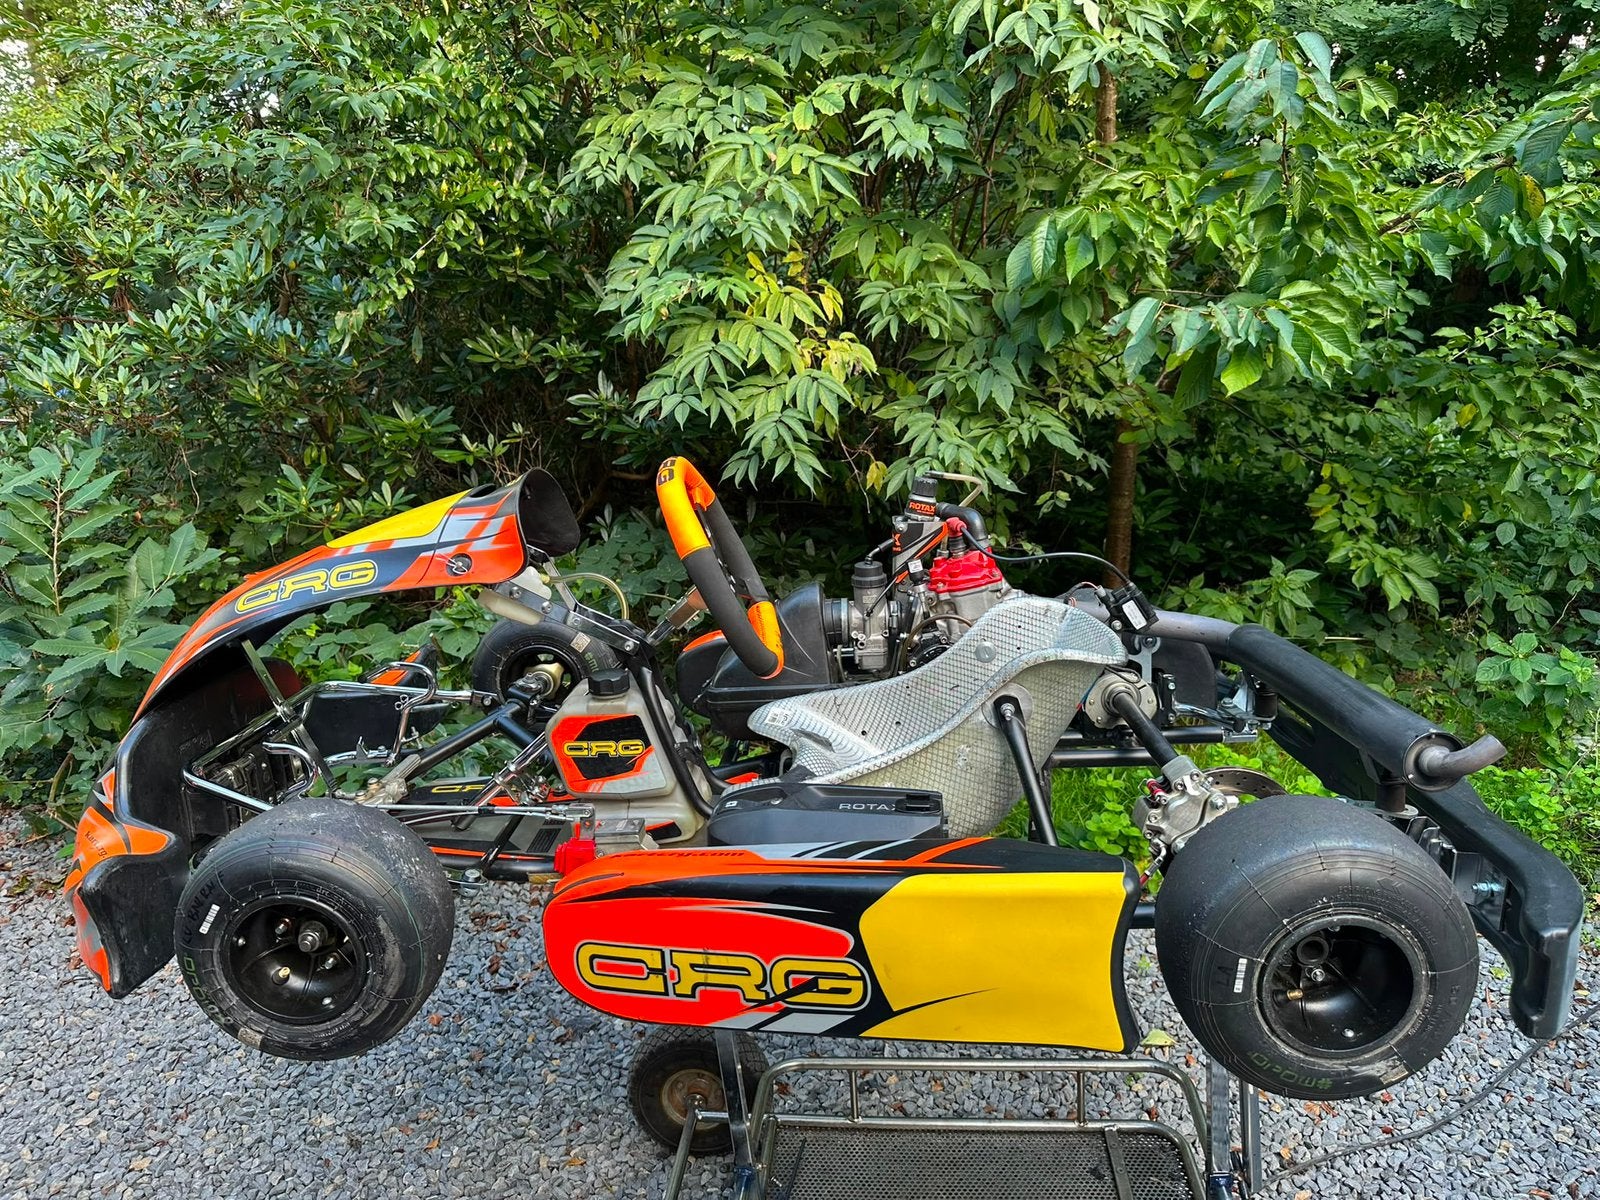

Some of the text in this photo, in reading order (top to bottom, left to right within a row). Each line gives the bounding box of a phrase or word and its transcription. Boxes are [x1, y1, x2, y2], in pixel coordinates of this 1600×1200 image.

[909, 502, 935, 513] ROTAX
[235, 559, 378, 614] CRG
[562, 740, 645, 757] CRG
[575, 940, 871, 1011] CRG
